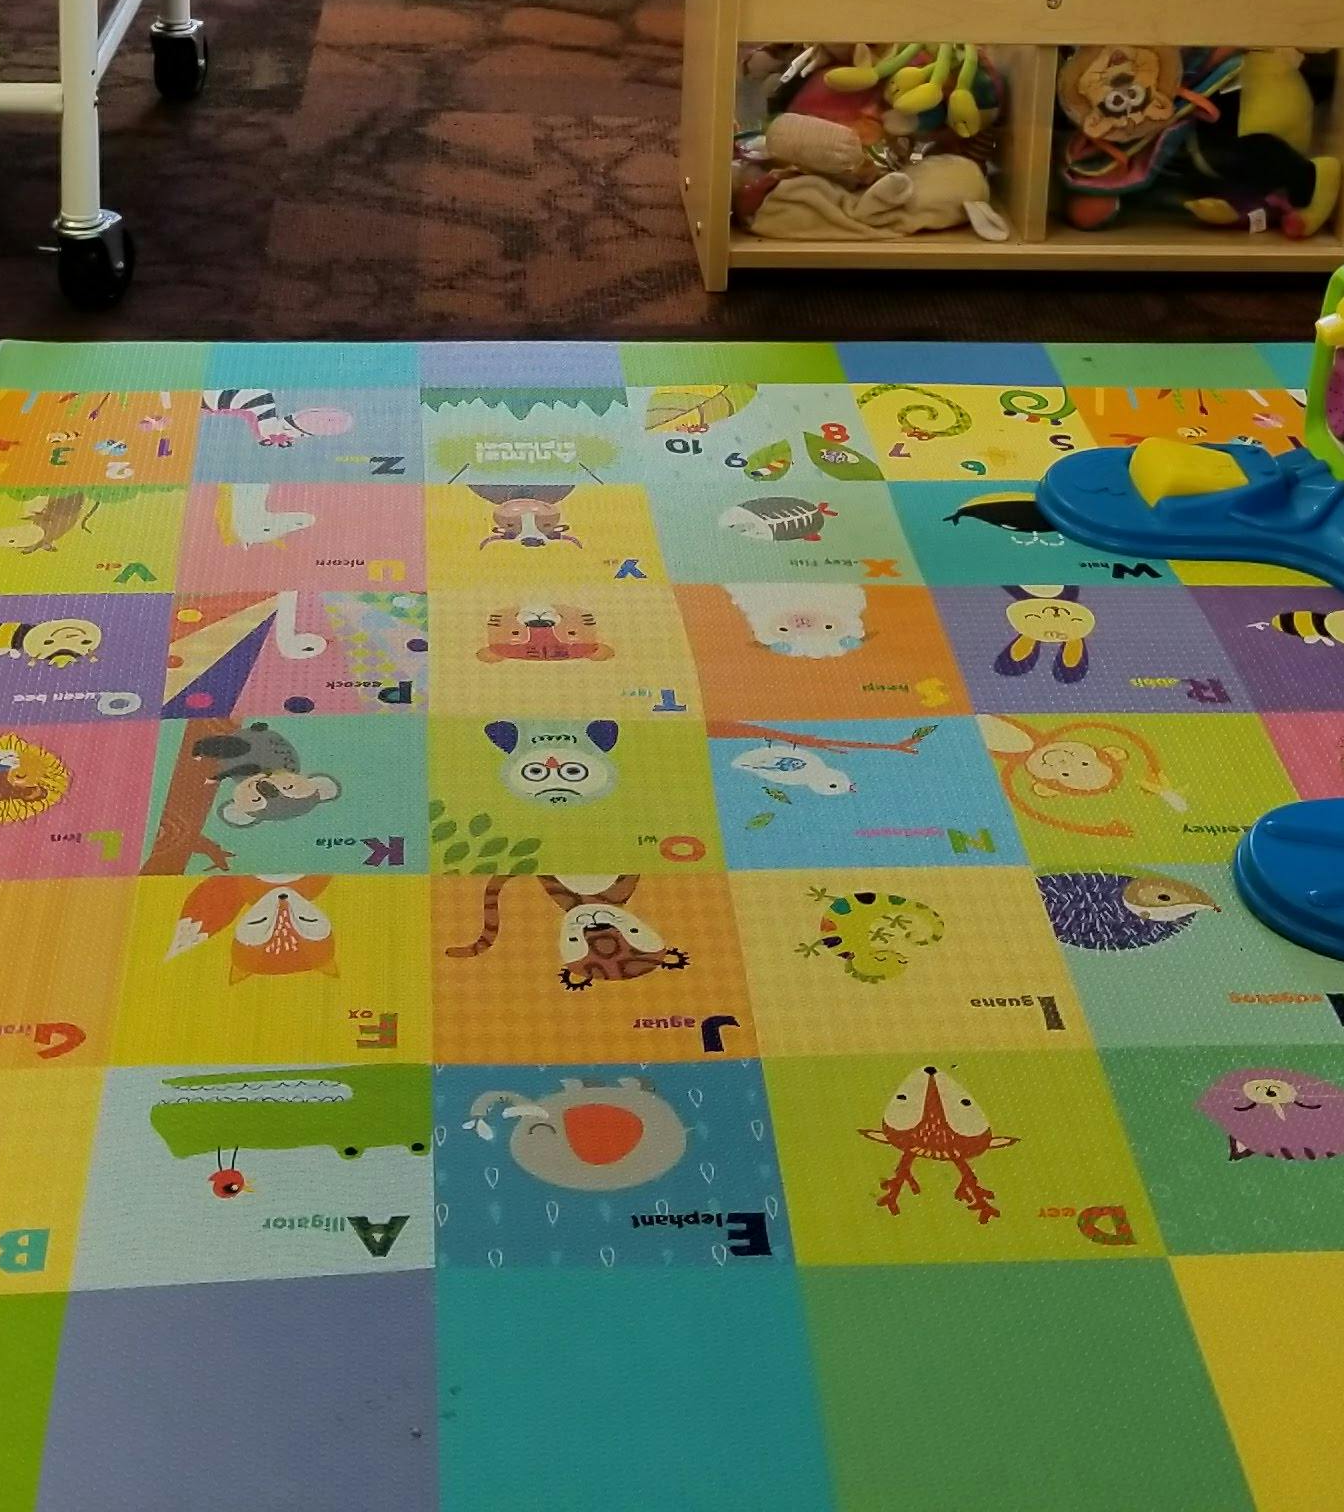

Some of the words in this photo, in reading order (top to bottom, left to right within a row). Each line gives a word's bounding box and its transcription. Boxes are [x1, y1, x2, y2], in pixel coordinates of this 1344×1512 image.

[820, 422, 851, 444] 8
[50, 448, 74, 466] 3
[158, 438, 173, 457] 1
[665, 437, 703, 456] 10
[889, 443, 912, 458] 7
[105, 461, 134, 480] 2
[724, 452, 749, 469] 9
[315, 558, 406, 582] Unicorn
[324, 680, 413, 705] Peacock
[315, 835, 405, 868] Koala
[637, 835, 706, 863] Owl
[970, 994, 1066, 1031] Iguana
[348, 1009, 399, 1048] Fox
[632, 1014, 741, 1053] Jaguar
[261, 1214, 410, 1258] Alligator
[630, 1211, 773, 1256] Elephant
[1037, 1205, 1138, 1246] Deer
